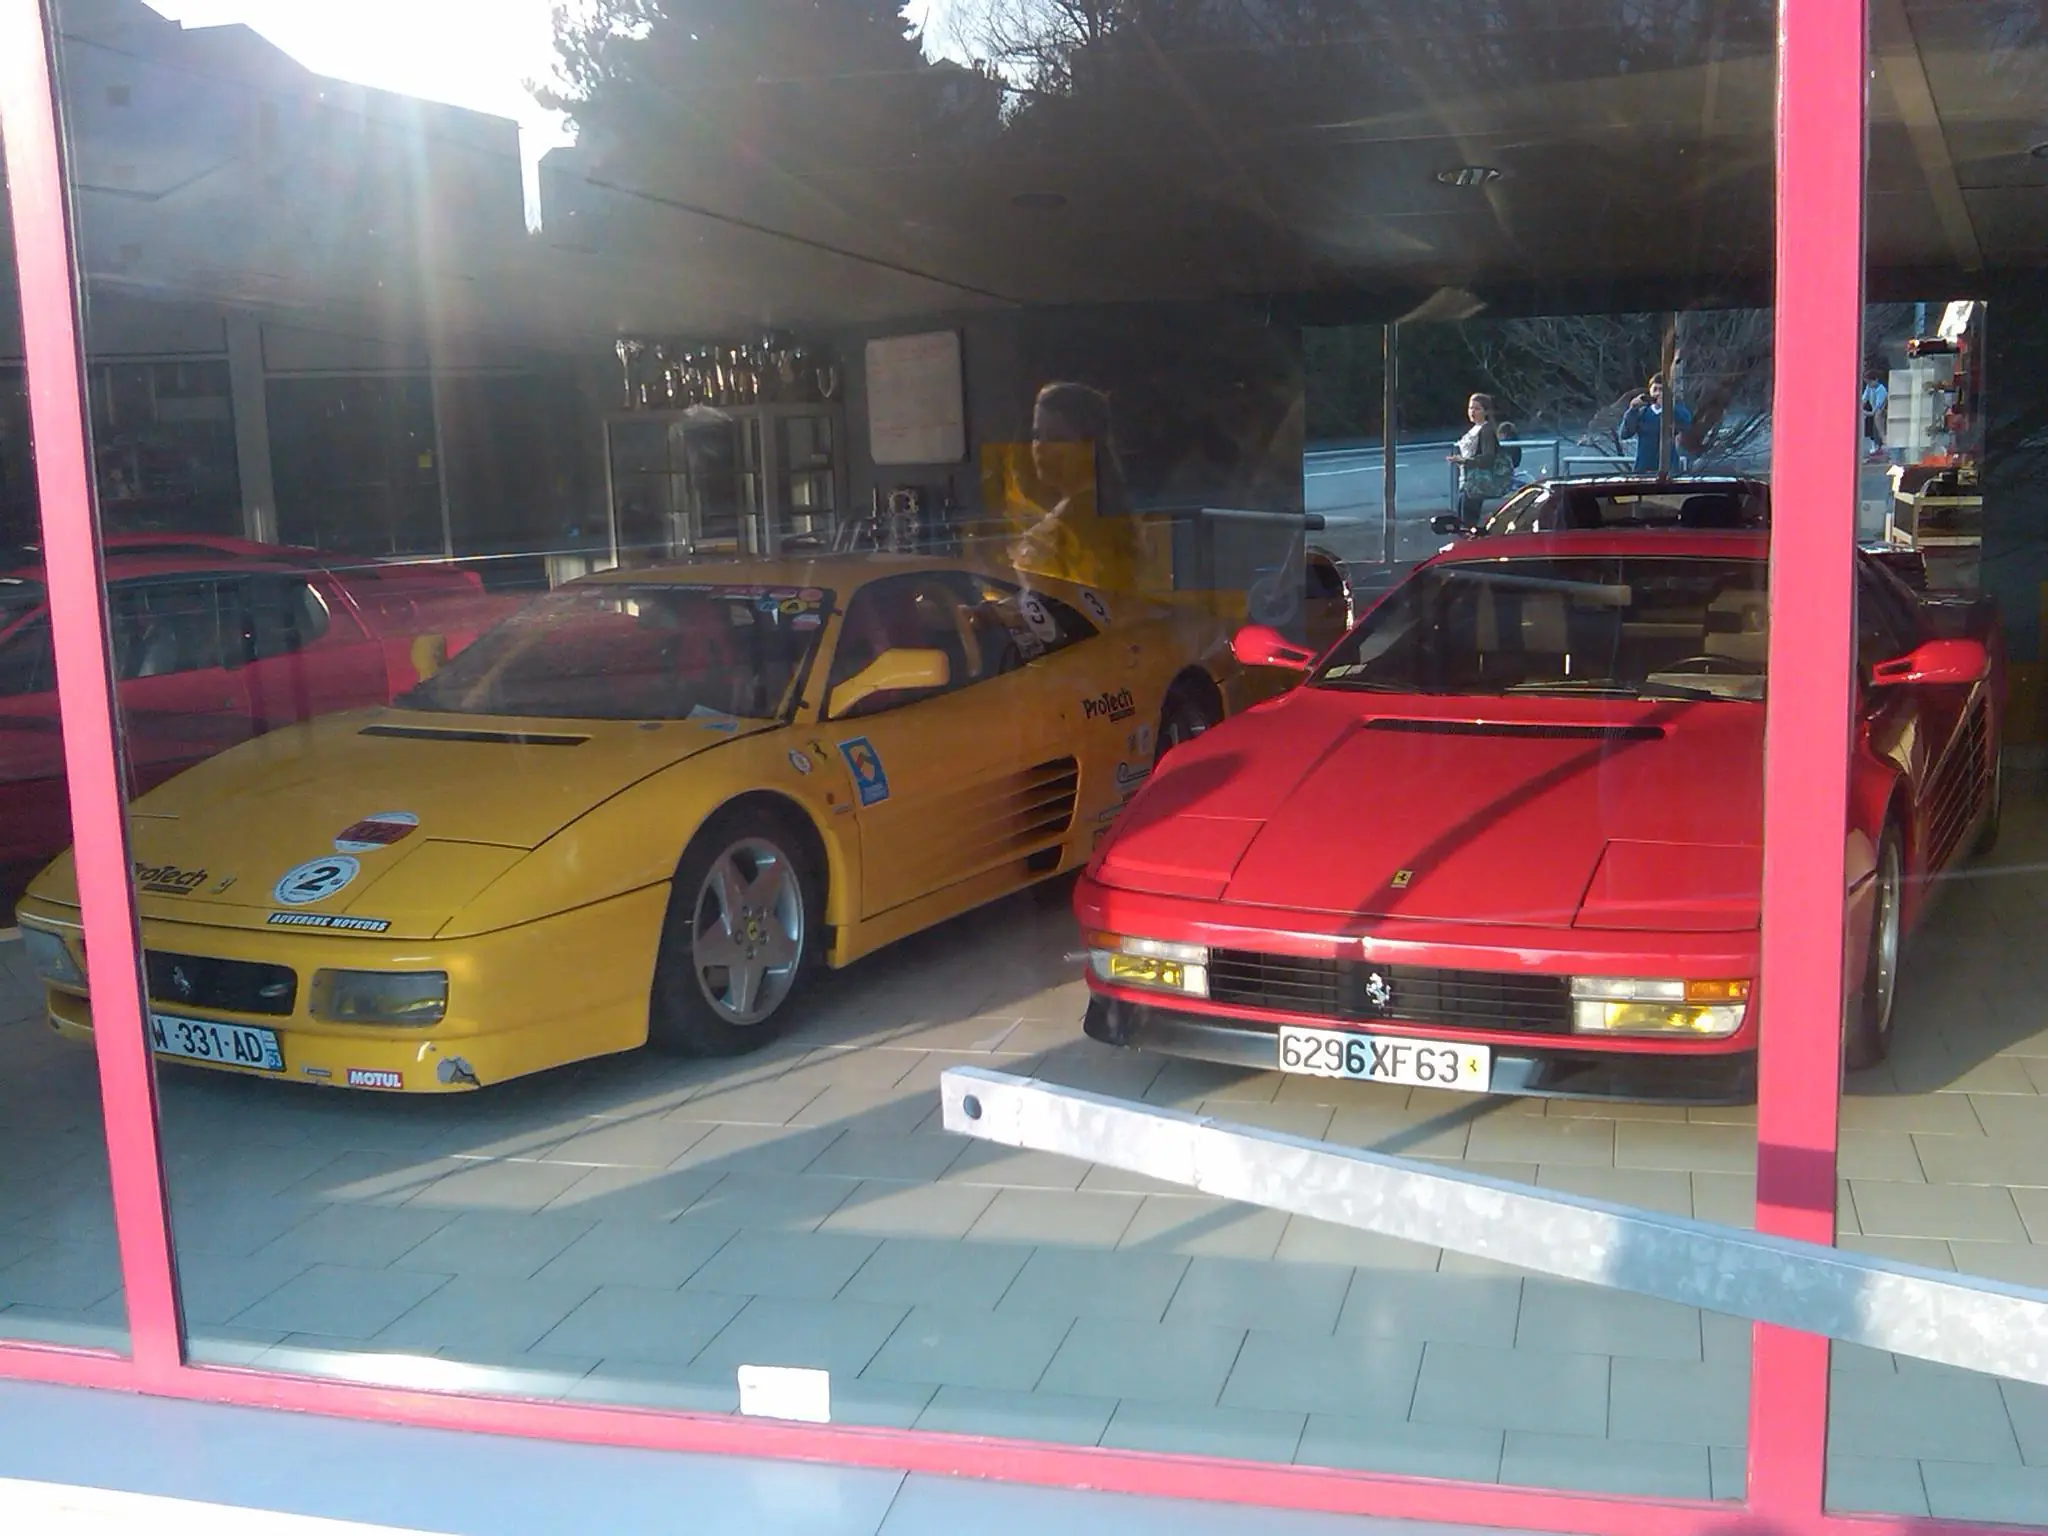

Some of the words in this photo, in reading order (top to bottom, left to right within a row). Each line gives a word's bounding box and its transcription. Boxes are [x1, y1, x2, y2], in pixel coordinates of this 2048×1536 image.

[1081, 688, 1135, 719] ProTech
[292, 866, 341, 892] 2
[270, 914, 331, 927] AUVERGNE
[329, 917, 389, 931] MOTEURS
[350, 1071, 402, 1088] MOTUL
